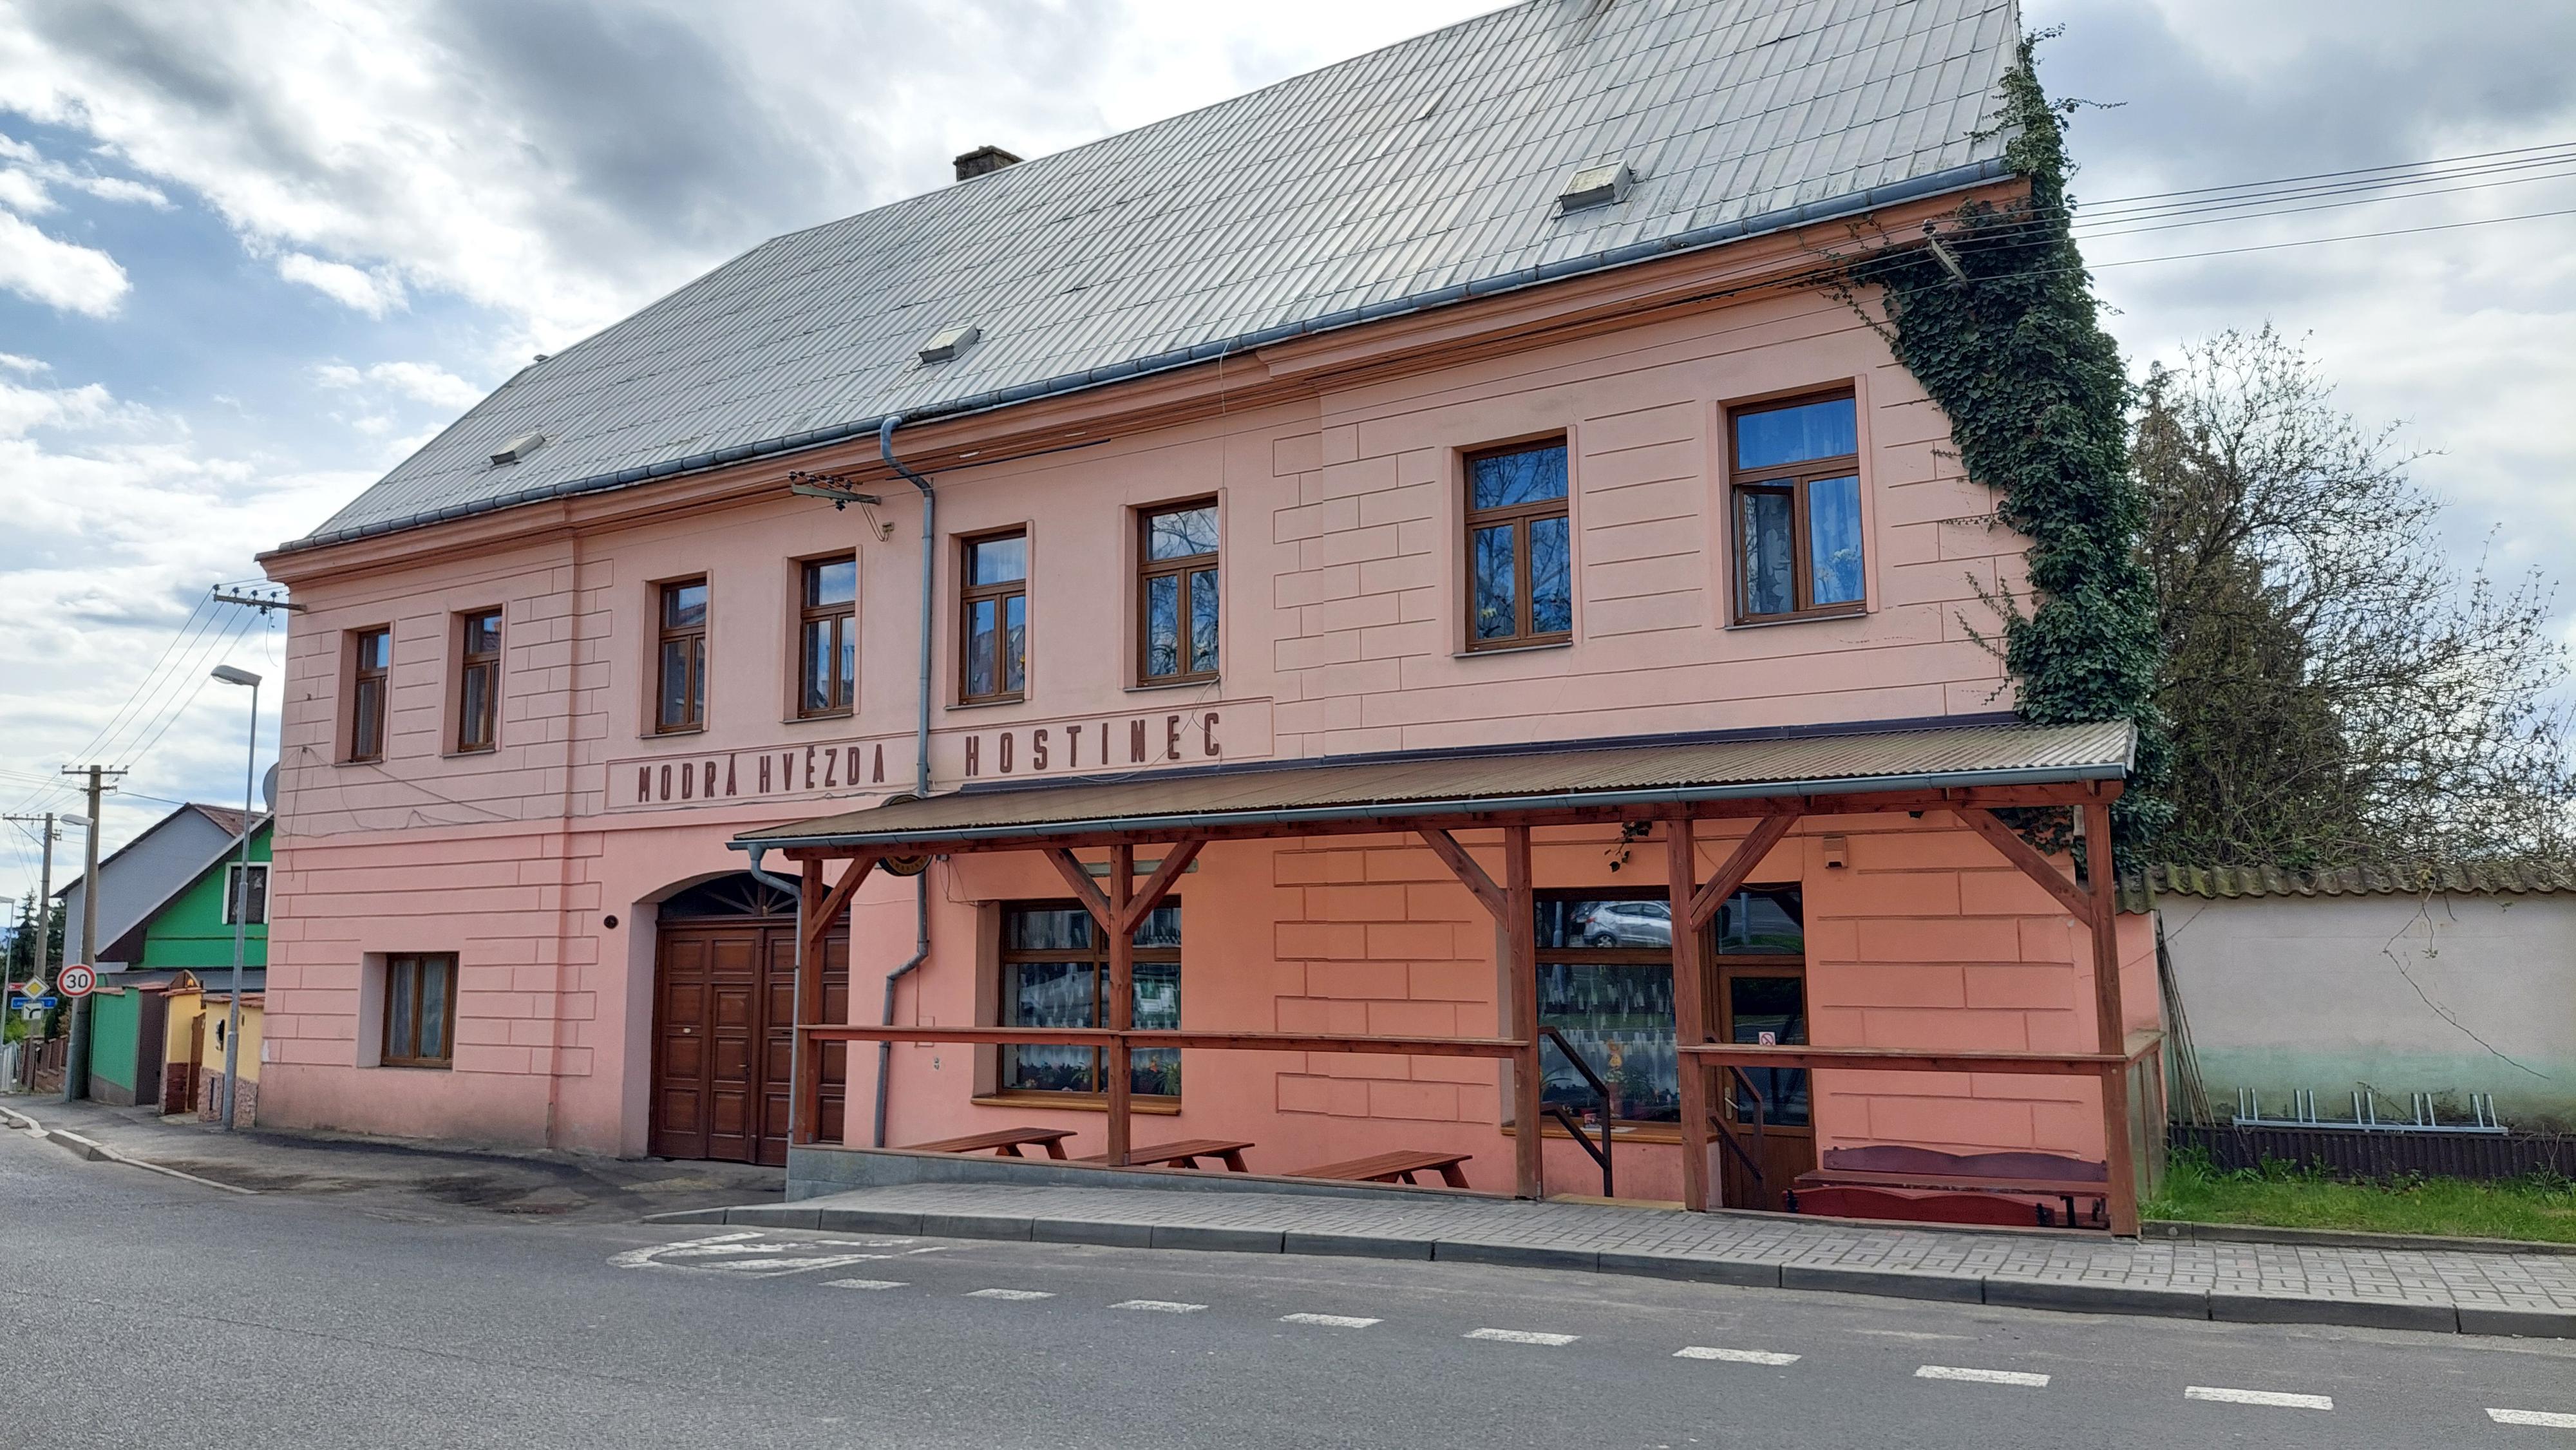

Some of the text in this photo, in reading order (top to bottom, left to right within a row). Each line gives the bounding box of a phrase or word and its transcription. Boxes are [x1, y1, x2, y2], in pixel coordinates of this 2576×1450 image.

[638, 753, 737, 803] MODRÁ
[965, 712, 1220, 777] HOSTINEC
[66, 974, 88, 989] 30
